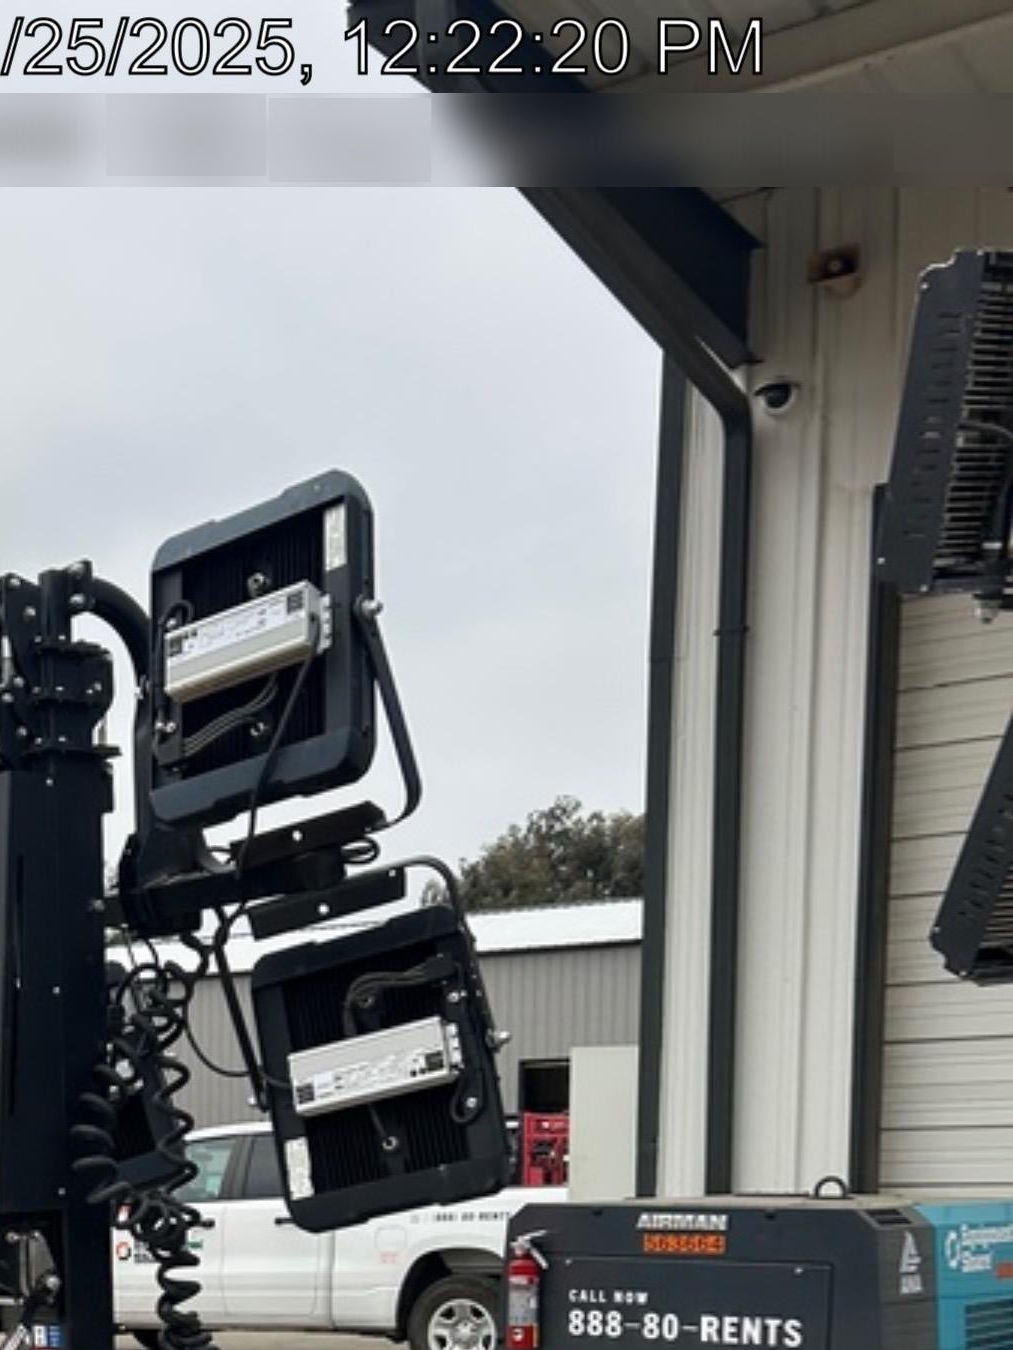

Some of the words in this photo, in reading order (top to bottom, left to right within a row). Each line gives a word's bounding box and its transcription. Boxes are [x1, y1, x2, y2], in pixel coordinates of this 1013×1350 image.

[636, 1212, 728, 1231] AIRMAN
[568, 1289, 606, 1303] CALL
[613, 1292, 648, 1304] NOW
[568, 1309, 803, 1348] 888-80-RENTS
